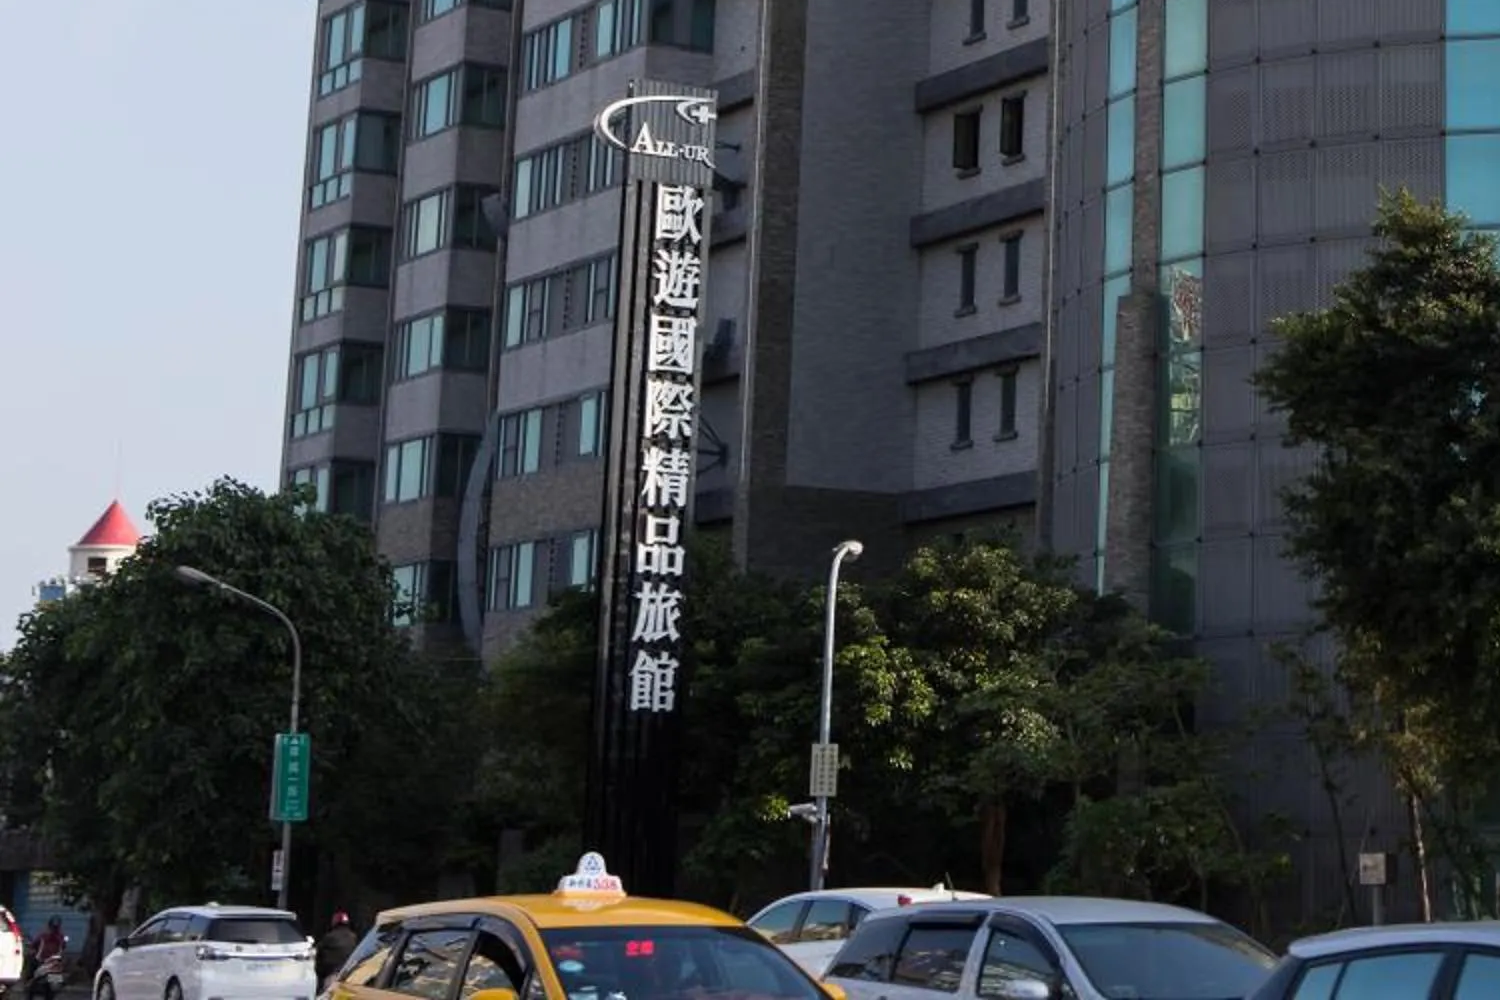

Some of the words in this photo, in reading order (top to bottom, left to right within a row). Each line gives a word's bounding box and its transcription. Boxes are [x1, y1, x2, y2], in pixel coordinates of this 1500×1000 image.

[628, 183, 705, 713] 歐遊國際精品旅館
